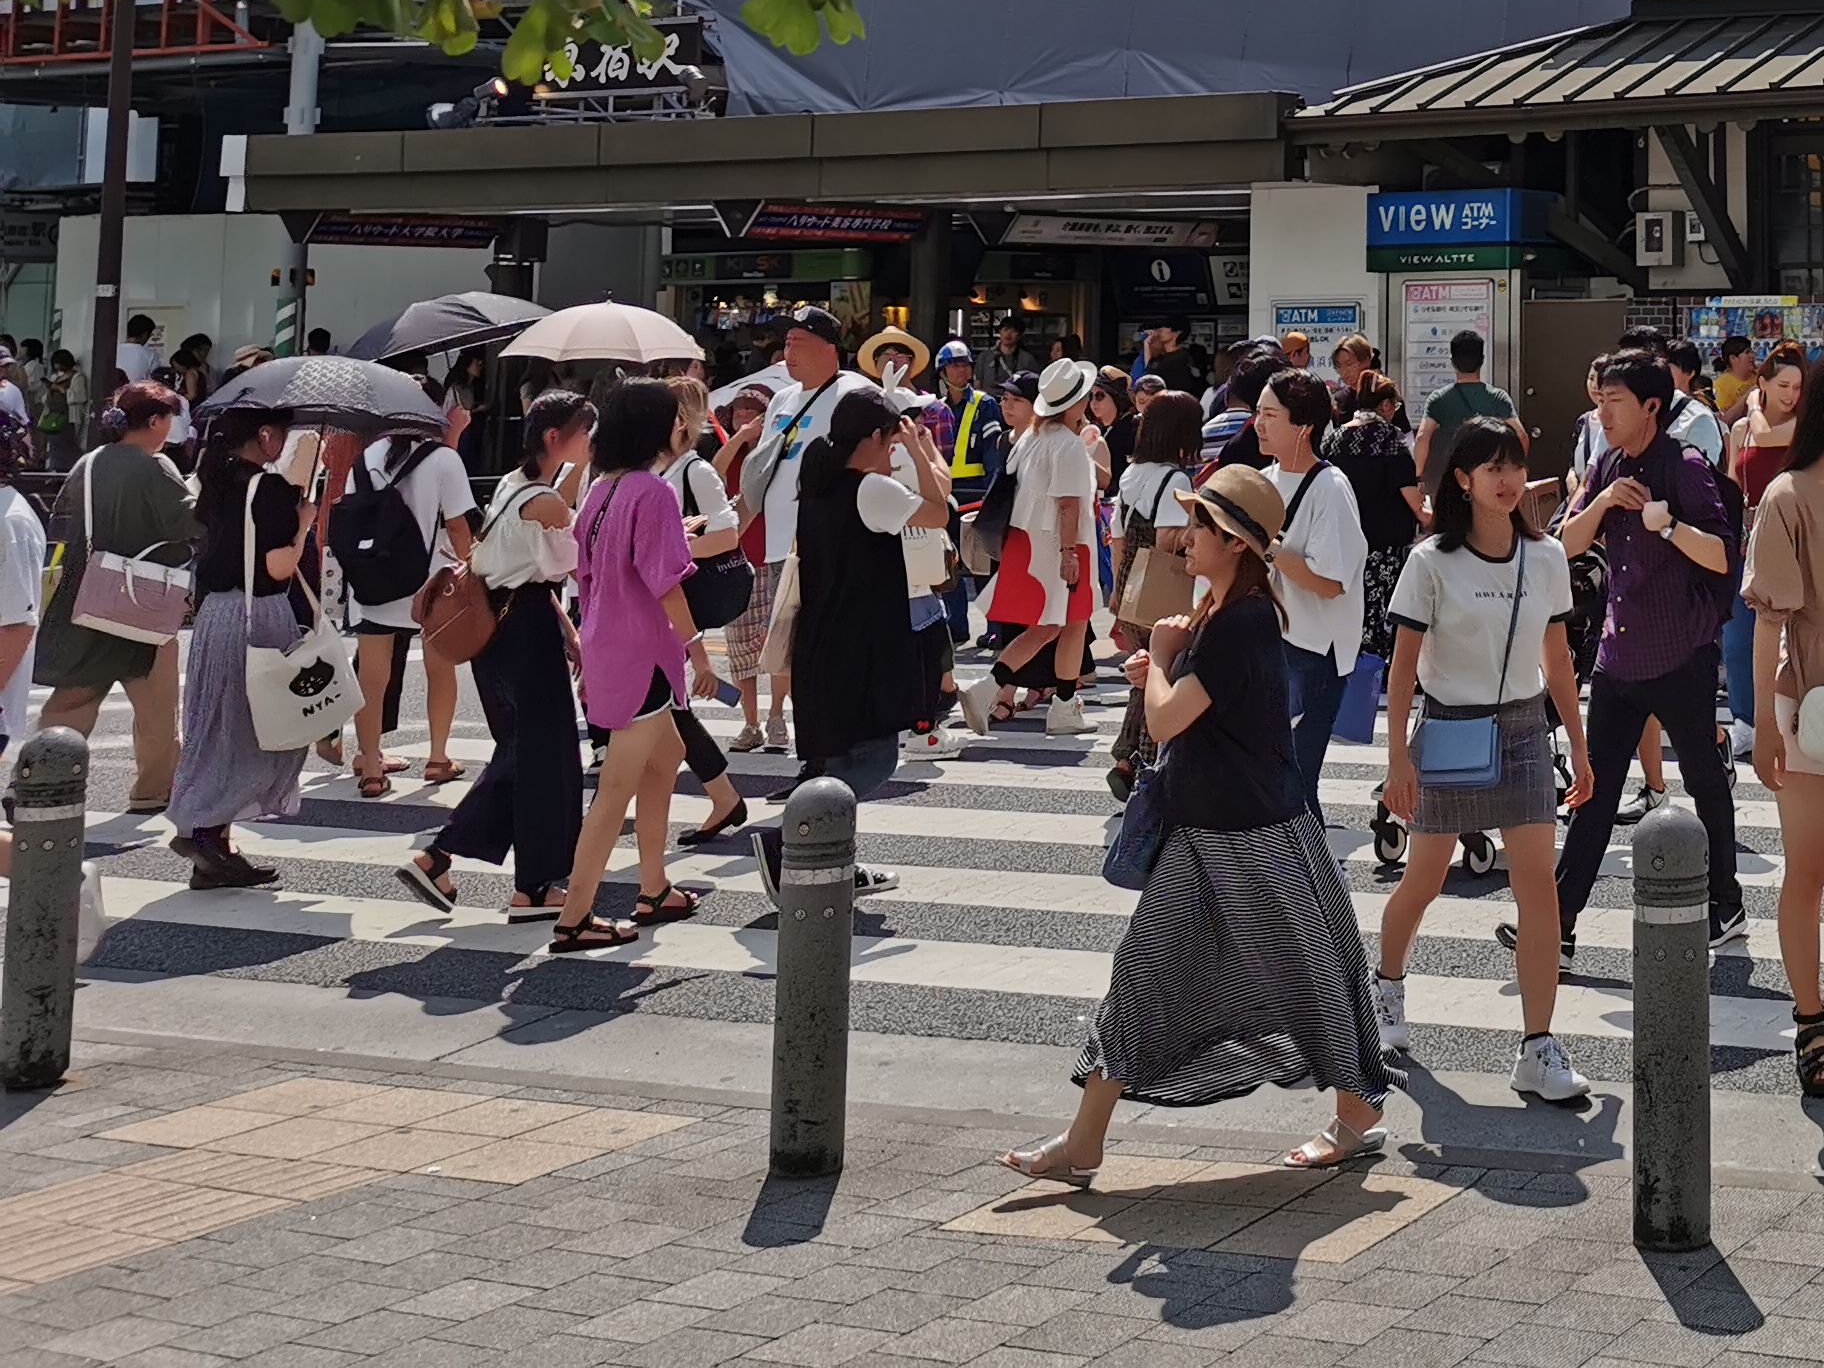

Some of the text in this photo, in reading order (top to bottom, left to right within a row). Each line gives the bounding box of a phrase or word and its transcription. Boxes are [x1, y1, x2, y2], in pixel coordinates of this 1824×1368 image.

[1461, 202, 1494, 217] ATM
[1461, 217, 1497, 230] コーナー
[725, 256, 781, 272] KISK
[1399, 254, 1475, 264] VIEW ALTTE
[1422, 285, 1450, 300] ATM
[1291, 309, 1319, 322] ATM
